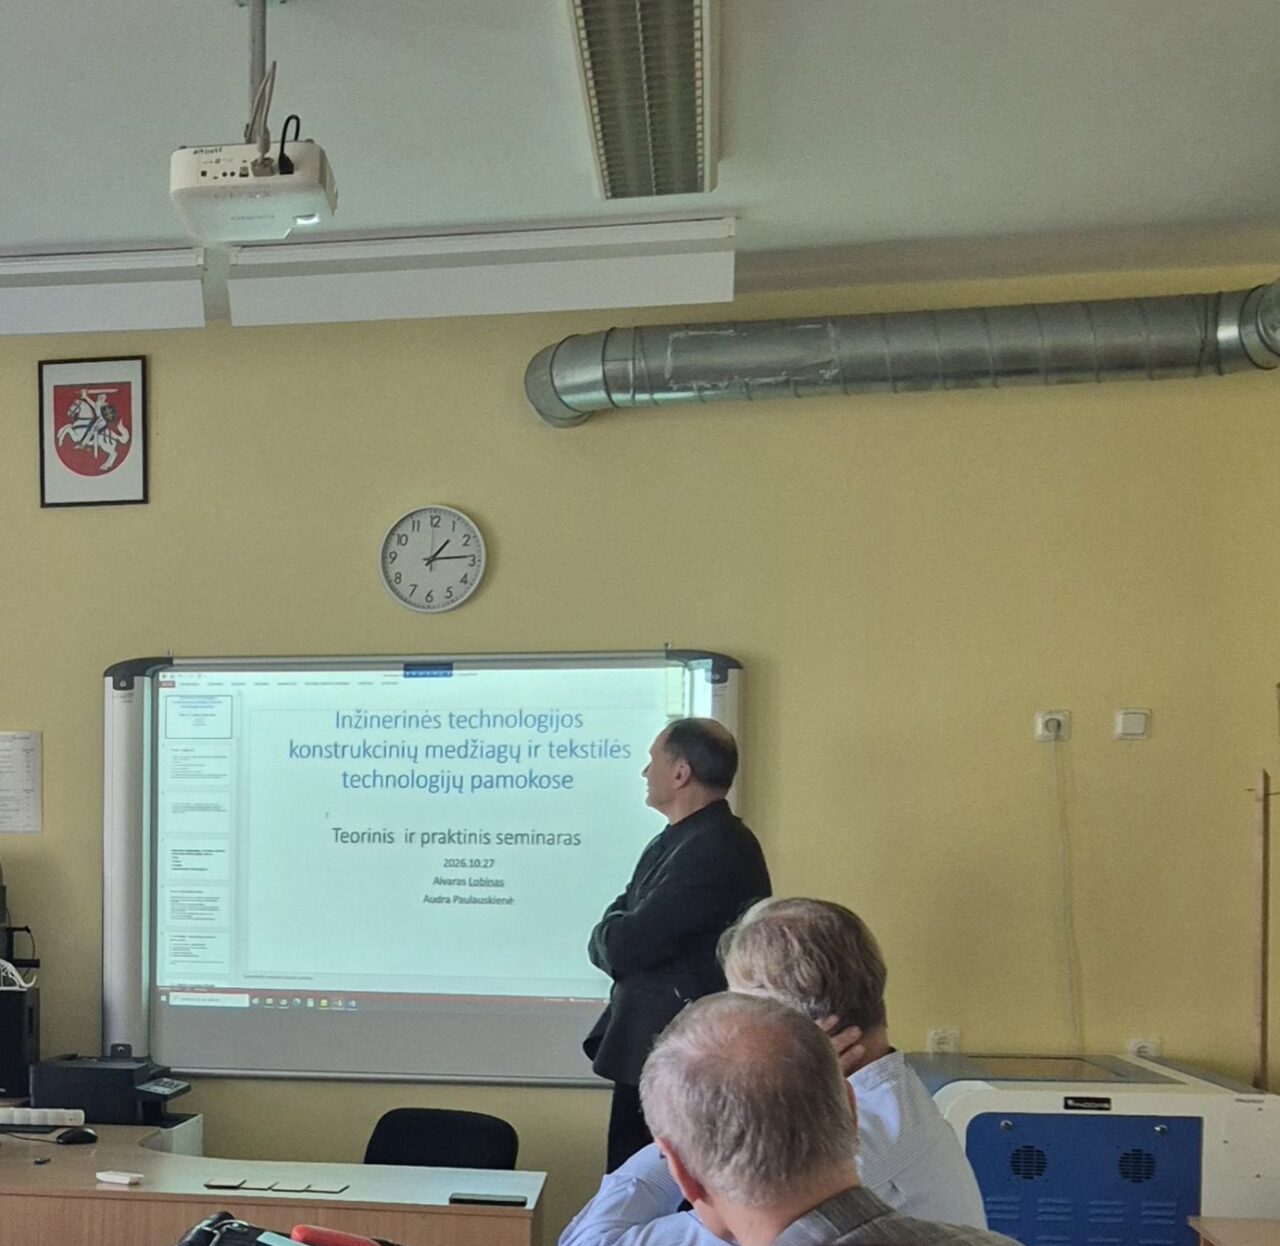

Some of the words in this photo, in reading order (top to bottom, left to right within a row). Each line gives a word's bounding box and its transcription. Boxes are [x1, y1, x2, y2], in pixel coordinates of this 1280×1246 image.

[412, 520, 420, 532] 11
[430, 515, 441, 528] 12
[397, 533, 408, 546] 10
[462, 534, 471, 546] 2
[389, 551, 398, 564] 9
[468, 554, 476, 567] 3
[394, 572, 402, 584] 8
[460, 573, 468, 584] 4
[409, 584, 418, 597] 7
[425, 589, 434, 603] 6
[445, 587, 453, 599] 5
[335, 709, 442, 729] Inžinerinės
[448, 709, 584, 733] technologijos
[289, 739, 418, 763] konstrukcinių
[425, 739, 521, 764] medžiagų
[528, 740, 541, 759] ir
[548, 739, 631, 759] tekstilės
[342, 769, 464, 794] technologijų
[471, 769, 574, 793] pamokose
[332, 828, 395, 844] Teorinis
[404, 828, 415, 844] ir
[421, 828, 491, 847] praktinis
[496, 829, 581, 846] seminaras
[423, 894, 451, 904] Audra
